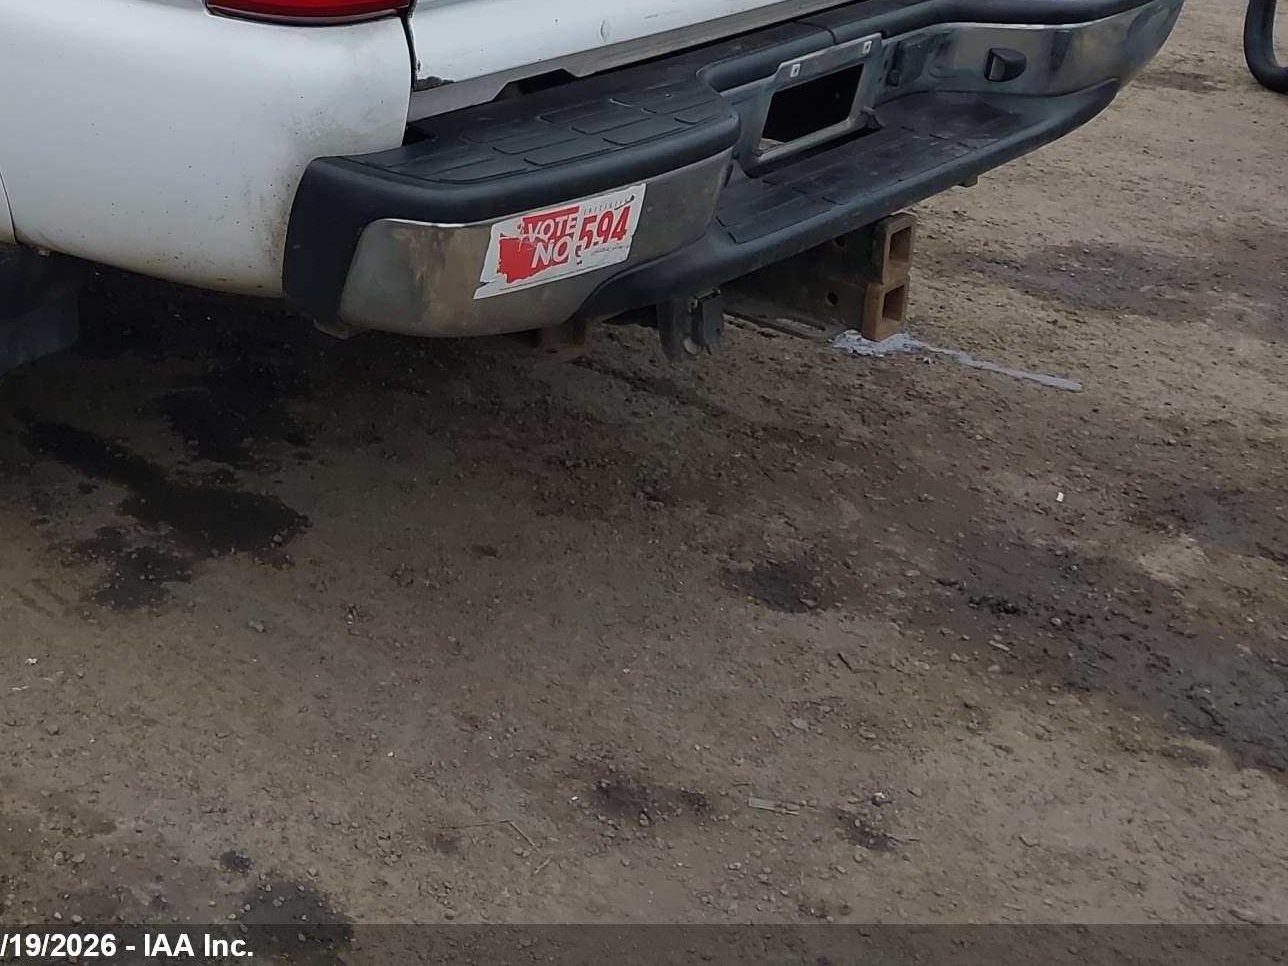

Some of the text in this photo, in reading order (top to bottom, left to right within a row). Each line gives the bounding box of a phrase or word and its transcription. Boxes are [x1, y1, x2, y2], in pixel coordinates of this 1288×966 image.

[526, 215, 578, 243] VOTE
[579, 205, 631, 251] 594
[530, 236, 572, 269] NO
